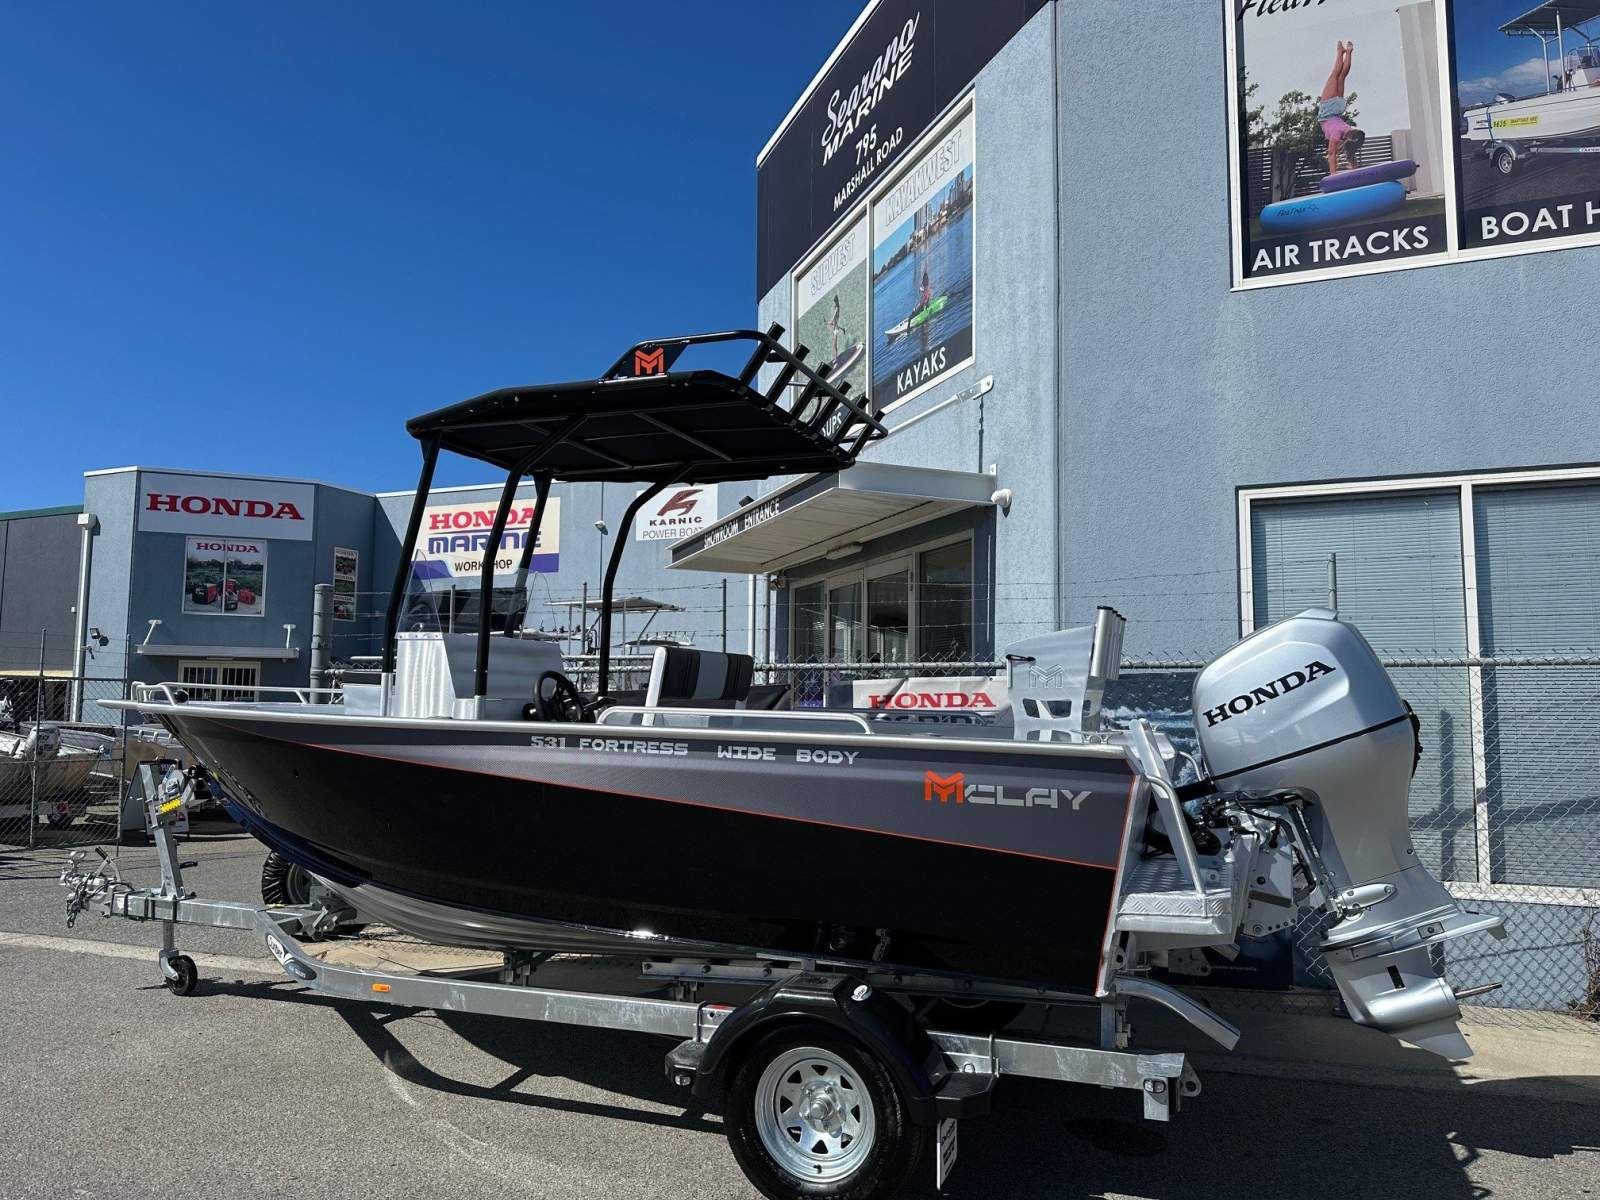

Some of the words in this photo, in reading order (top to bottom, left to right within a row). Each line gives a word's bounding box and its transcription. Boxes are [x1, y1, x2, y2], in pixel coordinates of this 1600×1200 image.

[822, 42, 915, 167] MARINE
[856, 123, 877, 165] 795
[833, 157, 875, 211] MARSHALL
[876, 126, 904, 166] ROAD
[886, 129, 962, 227] KAYAKWEST
[1481, 203, 1574, 240] BOAT
[1252, 244, 1300, 272] AIR
[1308, 225, 1430, 263] TRACKS
[896, 346, 946, 395] KAYAKS
[145, 493, 305, 521] HONDA
[648, 516, 703, 527] KARNIC
[744, 498, 780, 529] ENTRANCE
[196, 542, 261, 554] HONDA
[428, 530, 542, 554] MARNE
[642, 528, 677, 541] POWER
[868, 692, 997, 710] HONDA
[1202, 660, 1337, 728] HONDA
[530, 735, 567, 750] 531
[579, 737, 690, 756] FORTRESS
[717, 745, 777, 761] WIDE
[795, 749, 860, 765] BODY
